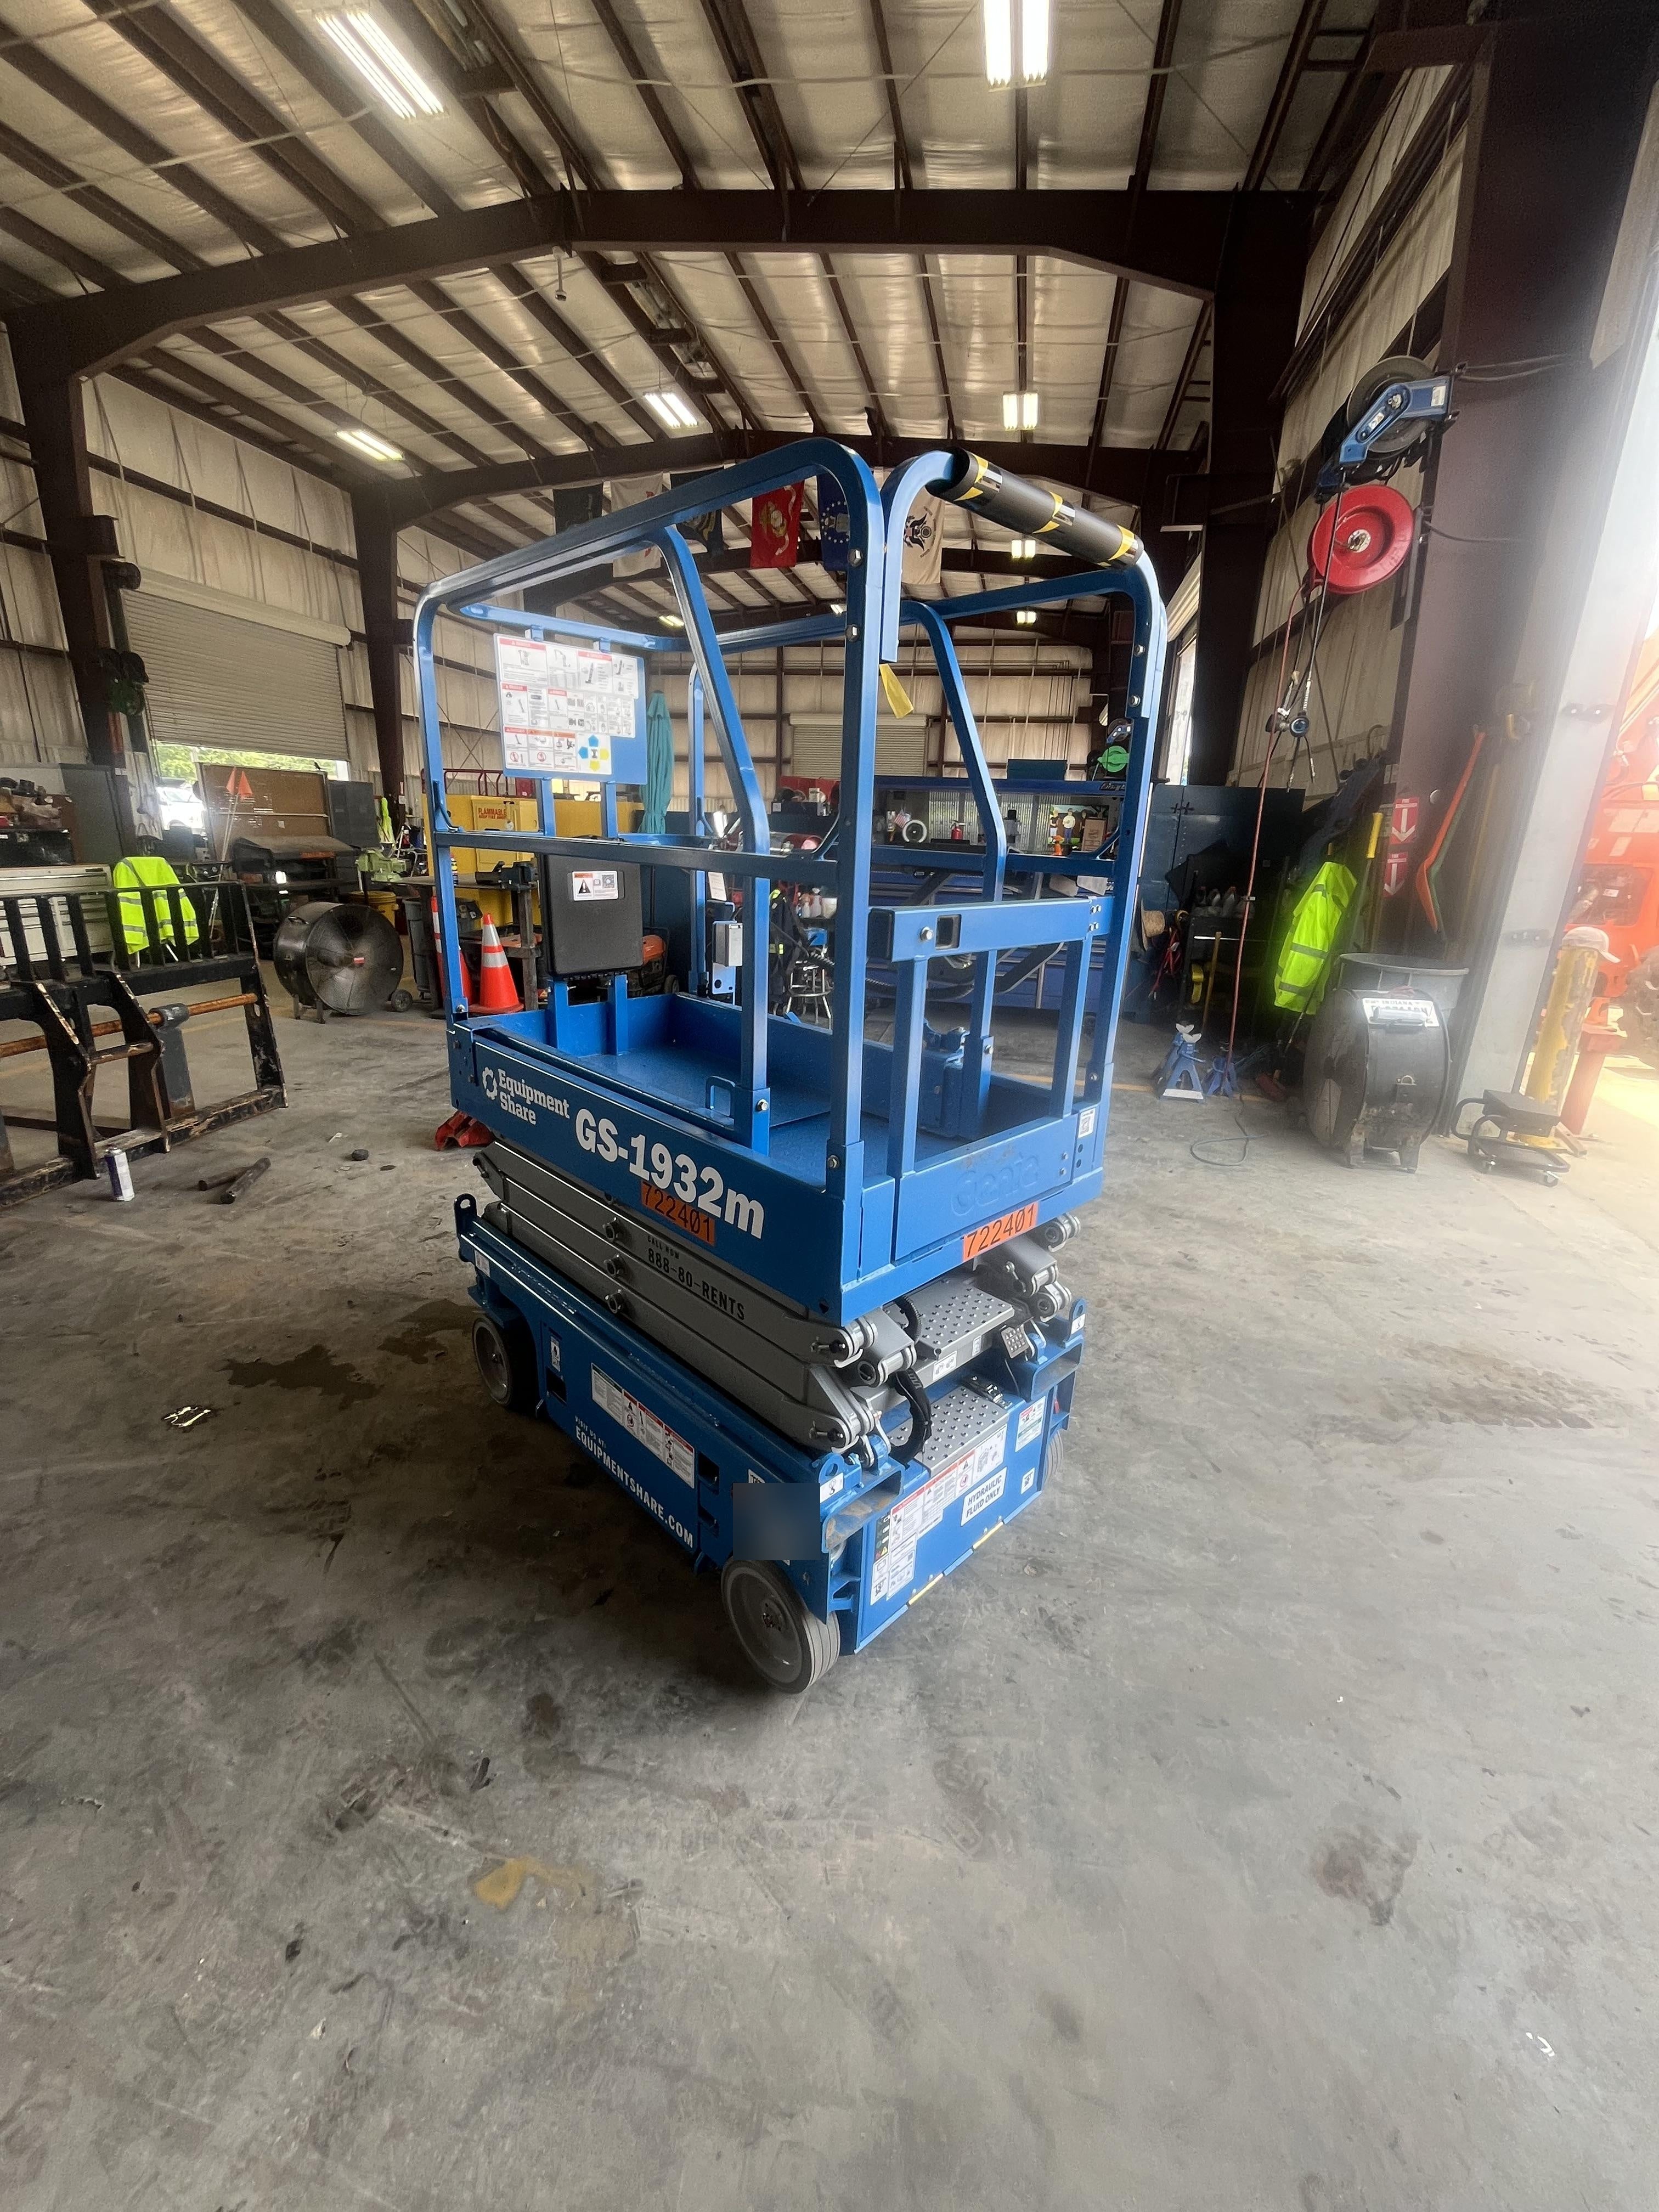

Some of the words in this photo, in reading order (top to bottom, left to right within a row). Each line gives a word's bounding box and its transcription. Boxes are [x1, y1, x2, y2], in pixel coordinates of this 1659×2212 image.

[497, 1069, 570, 1119] Equipment
[500, 1094, 537, 1125] Share
[575, 1108, 765, 1239] GS-1932m
[642, 1182, 712, 1242] 722401
[967, 1205, 1035, 1257] 722401
[647, 1235, 662, 1250] CALL
[665, 1246, 680, 1259] NOW
[648, 1248, 744, 1321] 888-80-RENTS
[575, 1425, 693, 1548] EQUIPMENTSHARE.COM
[966, 1500, 984, 1518] FLUID
[985, 1486, 1001, 1504] ONLY
[968, 1475, 1002, 1506] HYDRAULIC
